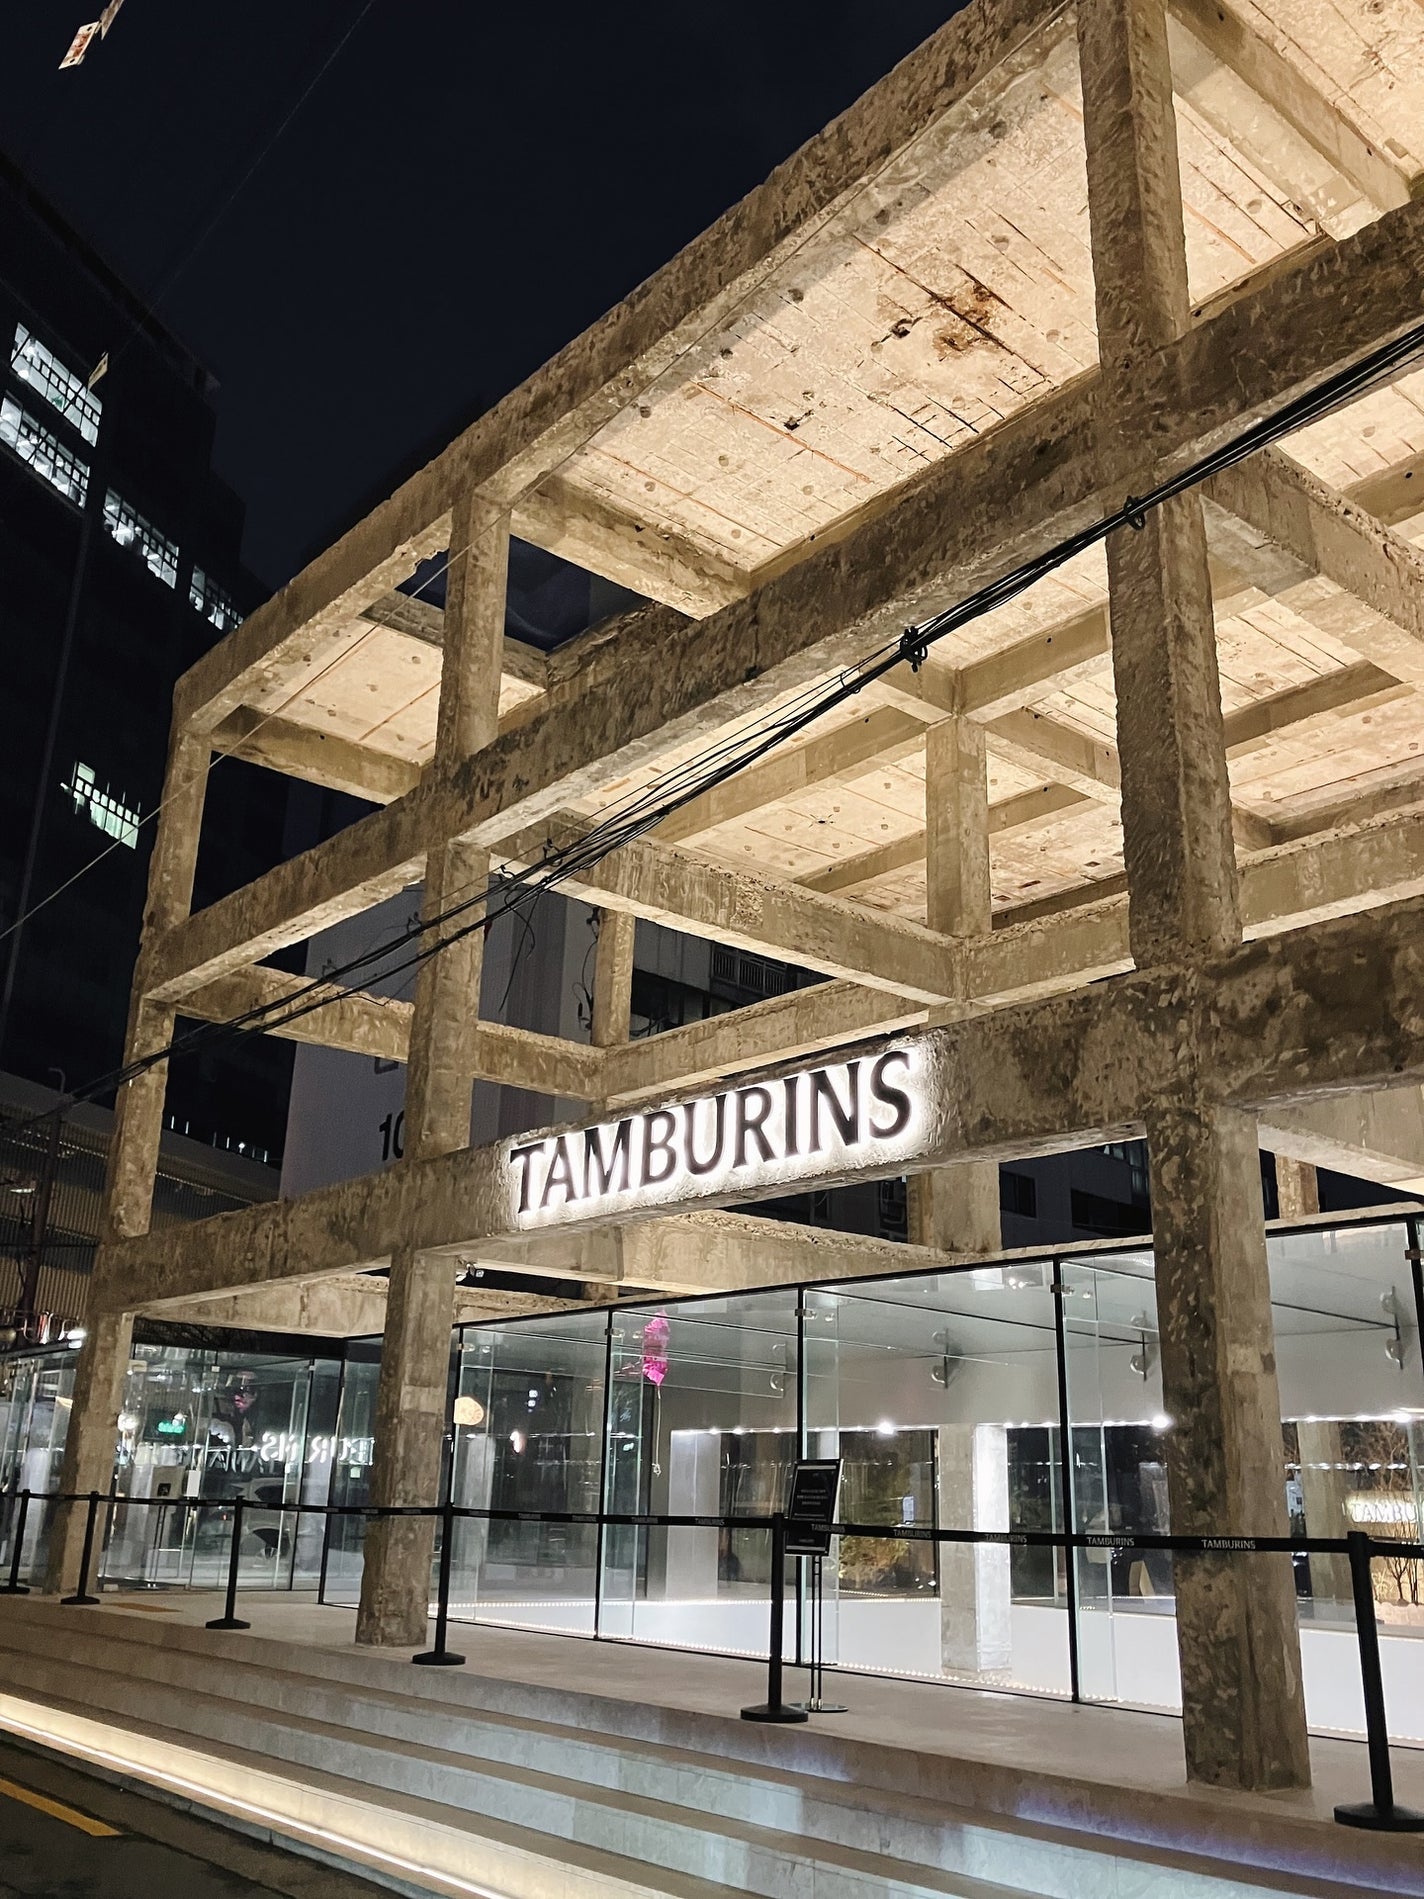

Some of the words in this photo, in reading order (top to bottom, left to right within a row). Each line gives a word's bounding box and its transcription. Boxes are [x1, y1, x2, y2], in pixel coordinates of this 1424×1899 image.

[510, 1050, 911, 1214] TAMBURINS
[1086, 1536, 1135, 1547] TAMBURINS
[1200, 1538, 1257, 1550] TAMBURINS
